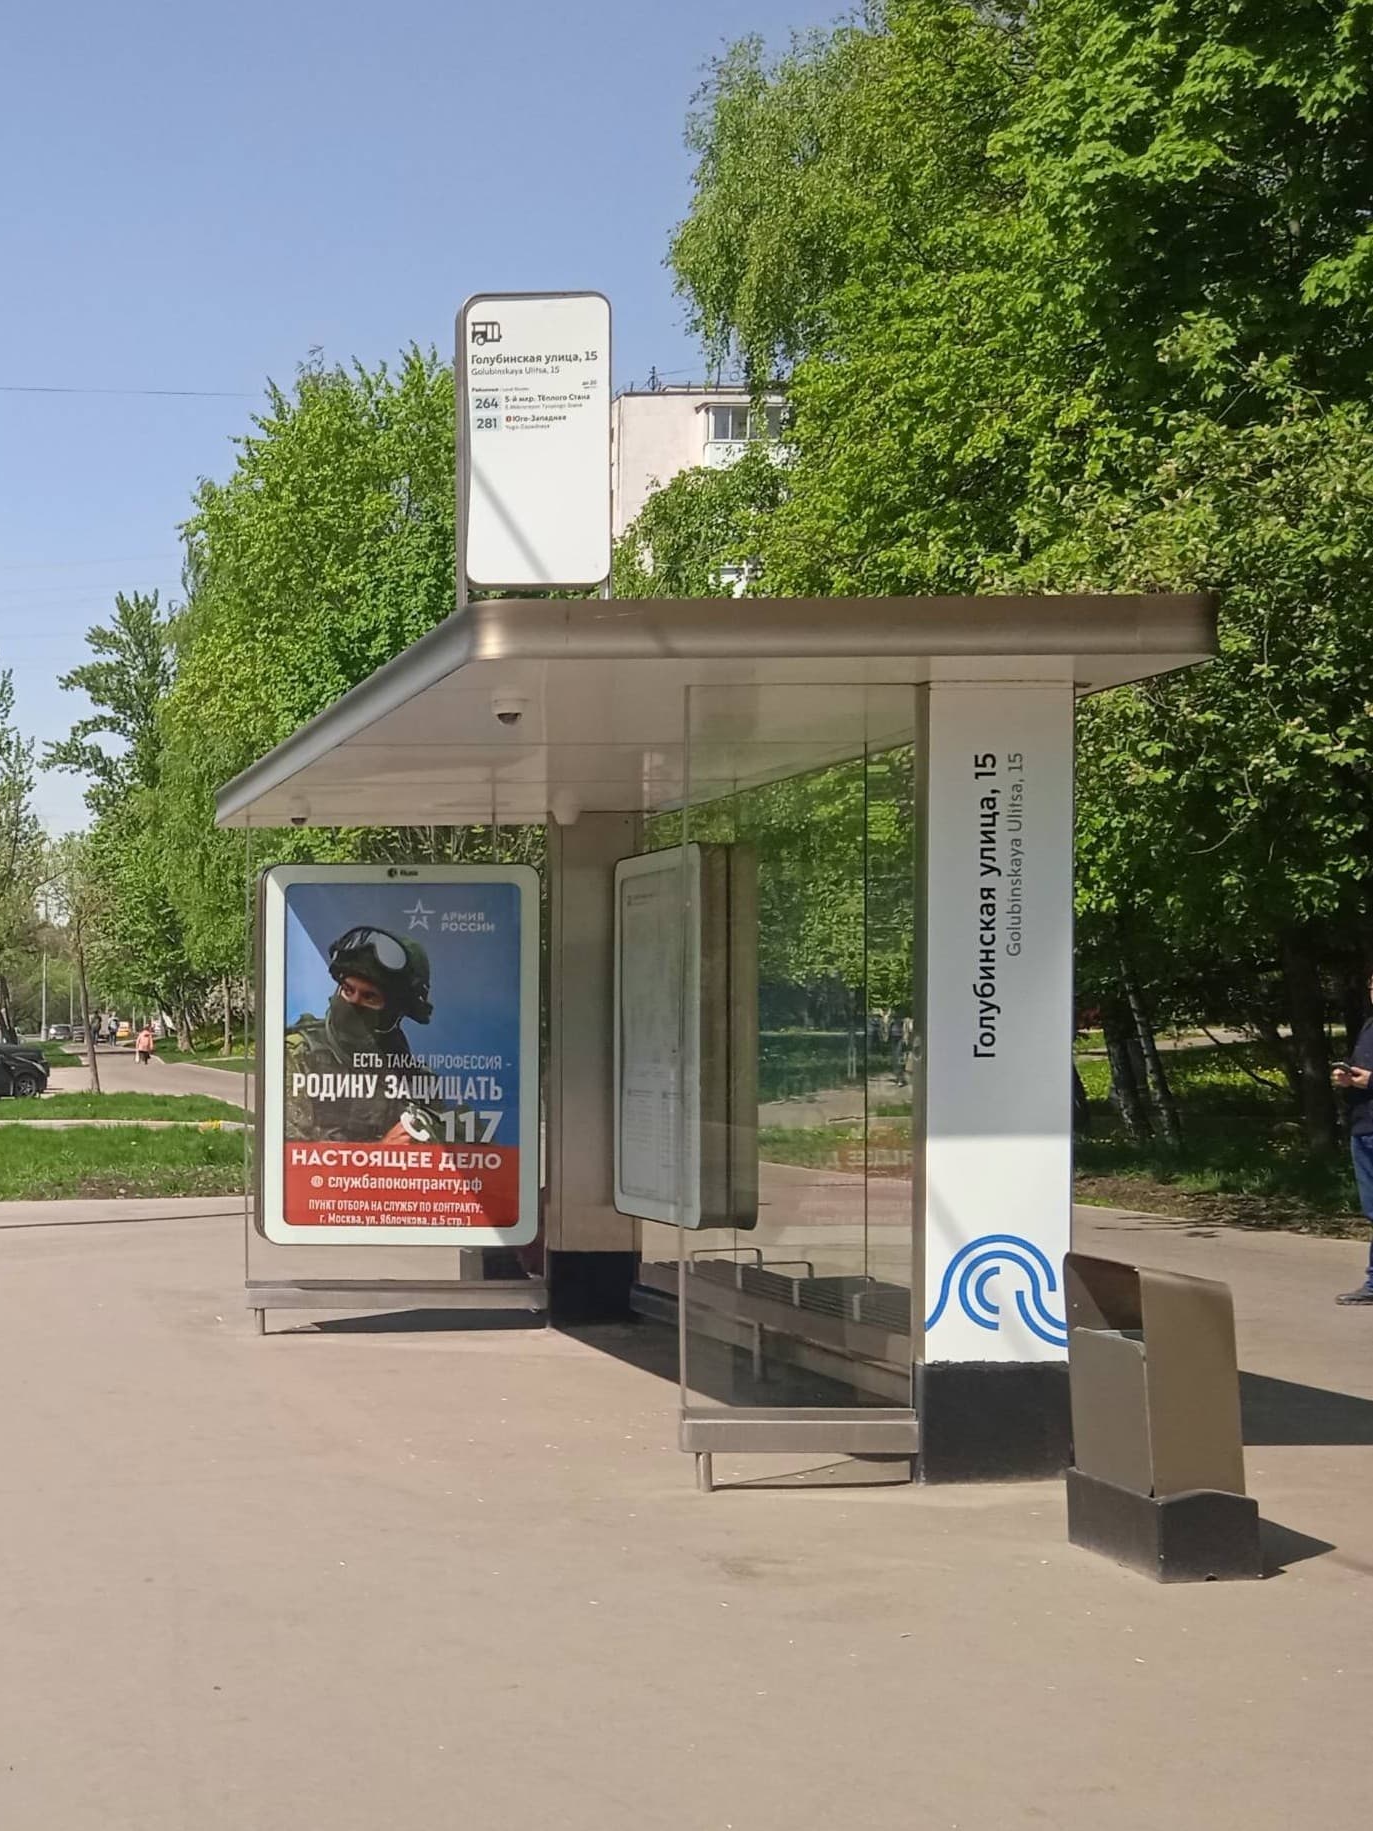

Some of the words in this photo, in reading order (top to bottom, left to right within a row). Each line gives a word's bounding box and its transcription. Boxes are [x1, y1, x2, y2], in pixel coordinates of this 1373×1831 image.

[471, 353, 542, 366] Голубинская
[544, 353, 582, 365] улица,
[584, 351, 598, 361] 15
[471, 366, 523, 376] Golubinskaya
[524, 366, 549, 375] Ulitsa,
[550, 365, 560, 374] 15
[475, 398, 499, 409] 264
[569, 393, 590, 401] Стана
[476, 418, 498, 429] 281
[512, 414, 567, 422] Юго-Западная
[974, 752, 997, 780] 15
[1008, 752, 1024, 773] 15
[1006, 778, 1025, 832] Ulitsa,
[979, 788, 1002, 877] улица,
[1006, 837, 1025, 957] Golubinskaya
[441, 911, 485, 921] АРМИЯ
[440, 922, 496, 932] РОССИИ
[973, 886, 1001, 1058] Голубинская
[353, 1052, 383, 1068] ЕСТЬ
[386, 1054, 426, 1069] ТАКАЯ
[428, 1055, 503, 1070] ПРОФЕССИЯ
[291, 1072, 378, 1102] РОДИНУ
[384, 1074, 503, 1106] ЗАЩИЩАТЬ
[438, 1110, 504, 1143] 117
[291, 1149, 433, 1171] НАСТОЯЩЕЕ
[438, 1151, 502, 1172] ДЕЛО
[327, 1173, 483, 1195] службапоконтракту.рф
[308, 1199, 336, 1211] ПУНКТ
[337, 1200, 370, 1211] ОТБОРА
[371, 1200, 382, 1212] НА
[383, 1201, 418, 1213] СЛУЖБУ
[419, 1201, 432, 1212] ПО
[433, 1202, 484, 1214] КОНТРАКТУ:
[319, 1214, 326, 1224] г.
[365, 1215, 379, 1226] ул.
[466, 1215, 472, 1226] 1
